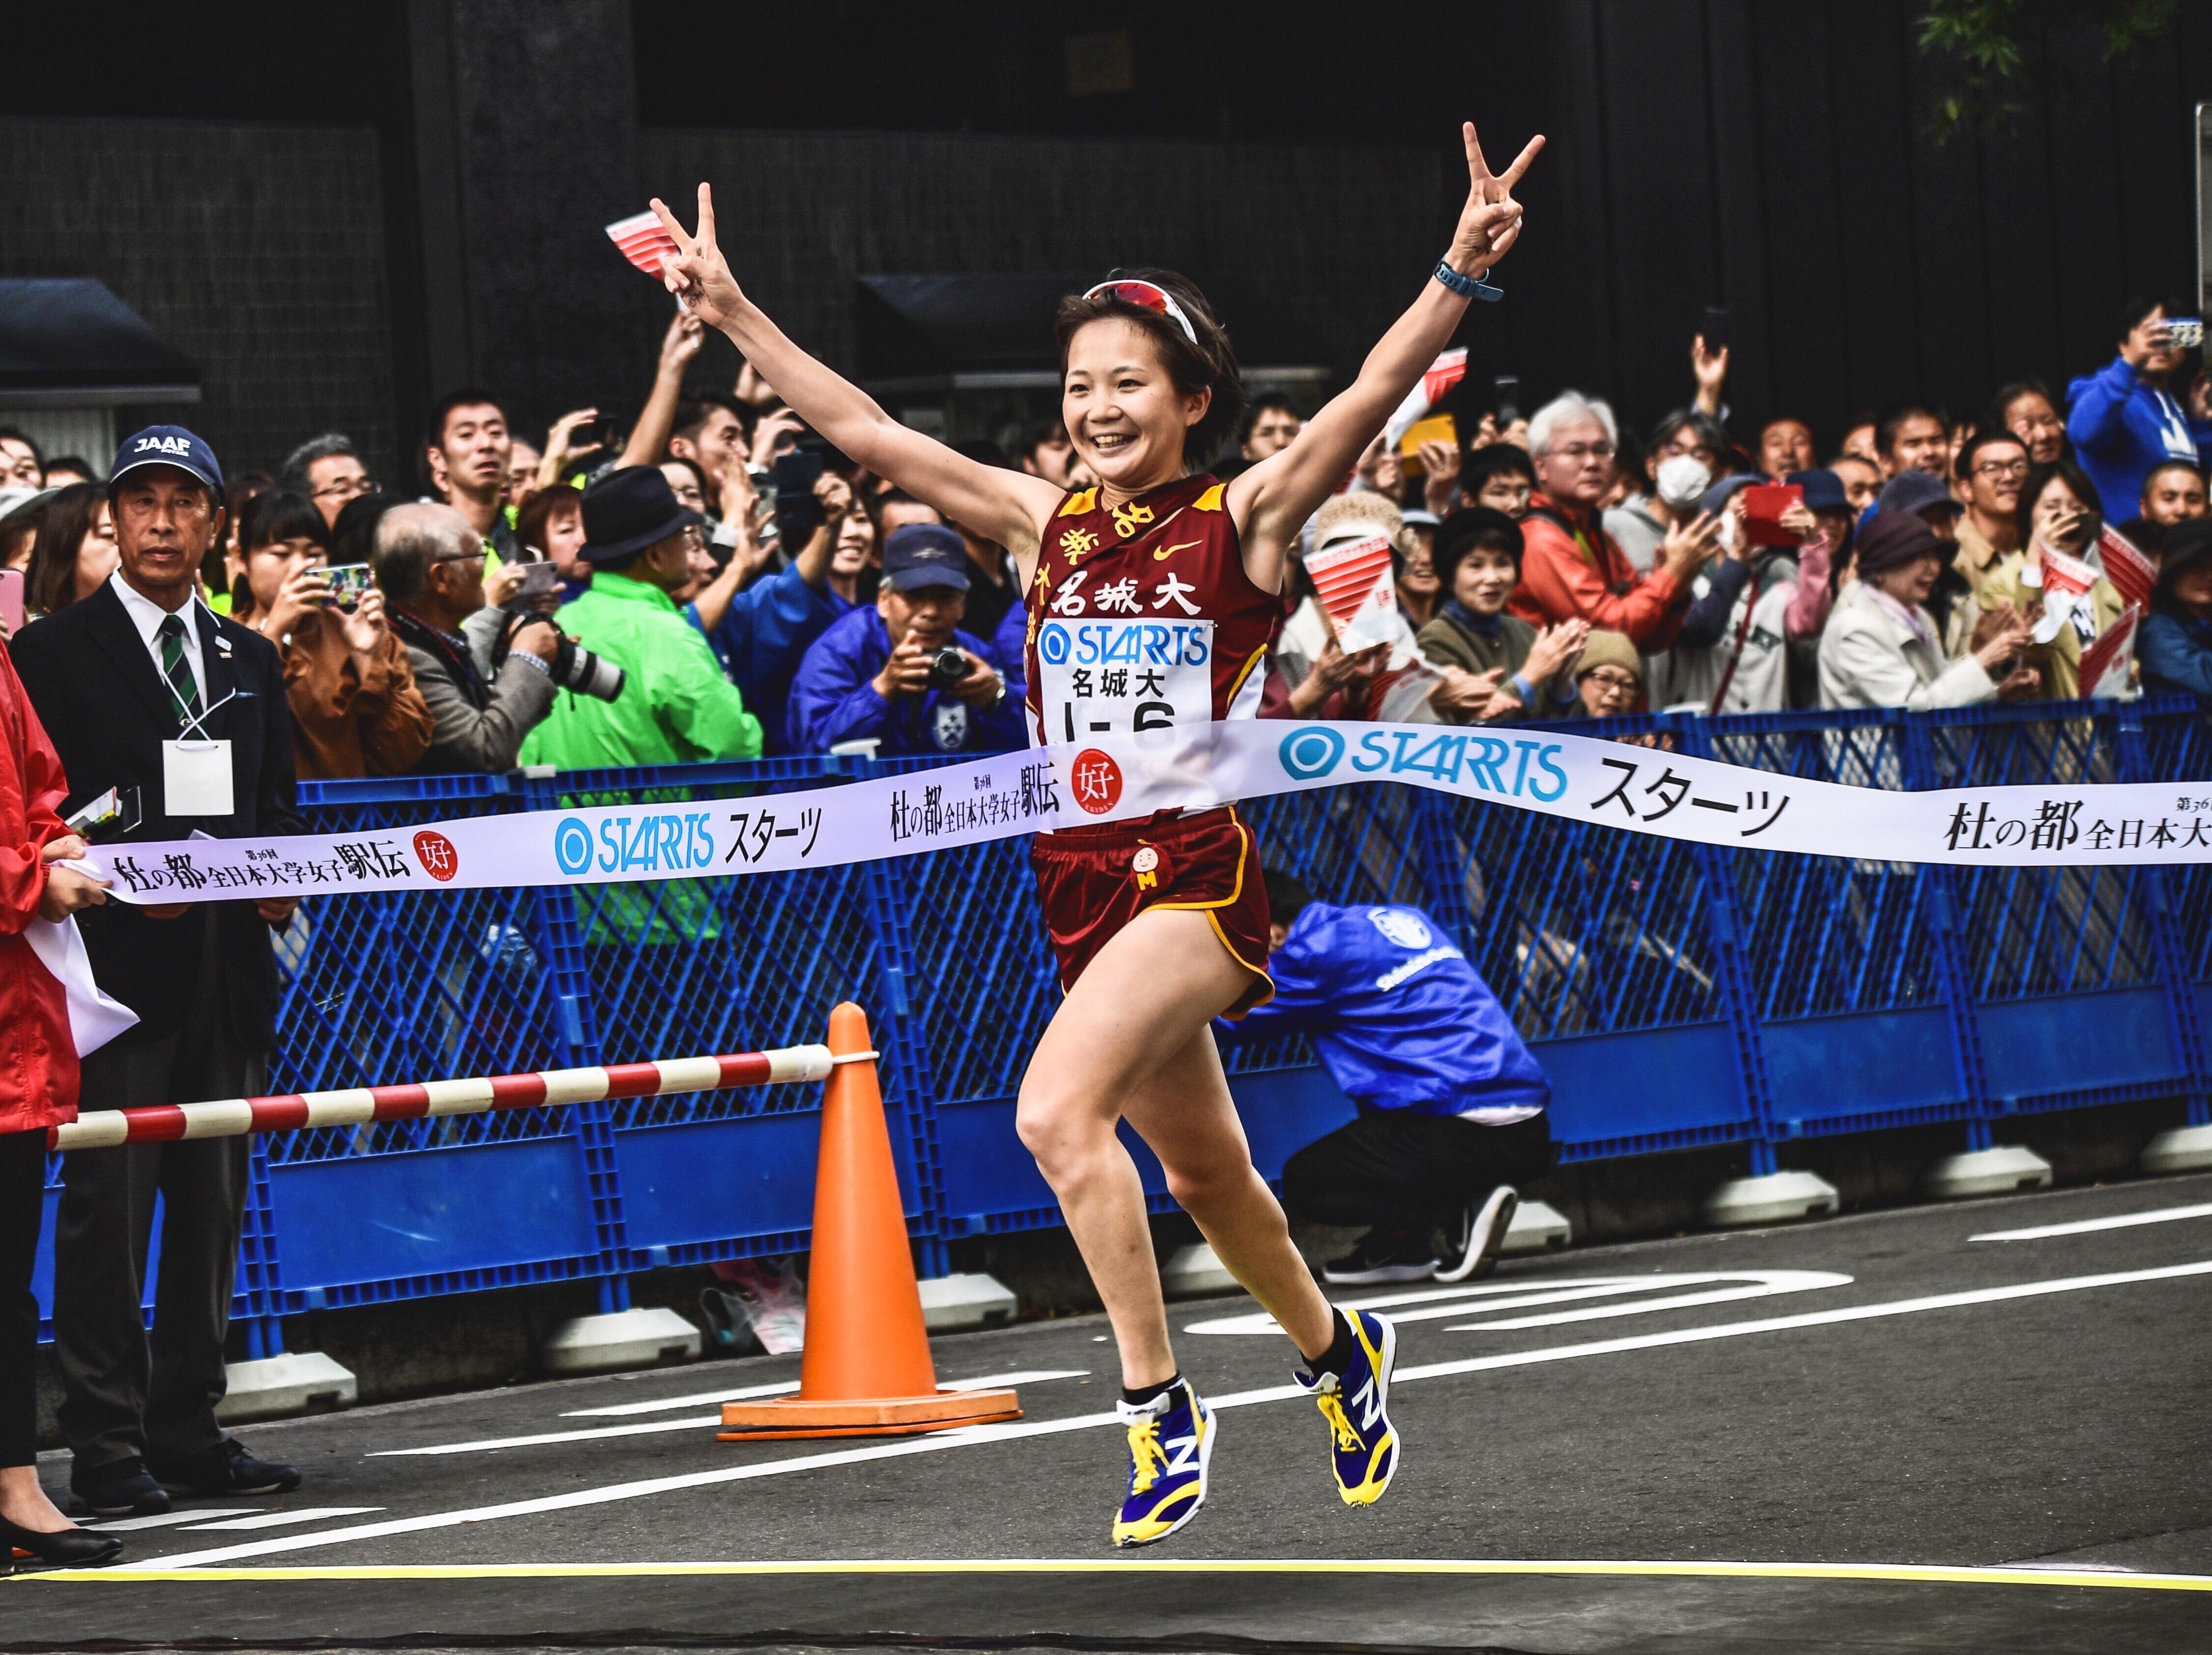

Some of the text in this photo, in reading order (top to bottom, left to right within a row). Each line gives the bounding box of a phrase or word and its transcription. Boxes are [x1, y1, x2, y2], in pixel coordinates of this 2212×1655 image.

[134, 436, 191, 453] JAAF
[1051, 570, 1202, 616] 名城大
[1072, 668, 1165, 698] 名城大
[1064, 701, 1175, 743] 1-6
[973, 774, 991, 792] 第36回
[1076, 761, 1115, 802] 好
[1590, 757, 1790, 837] スターツ
[2176, 797, 2212, 813] 第36
[725, 807, 822, 864] スターツ
[245, 848, 279, 862] 第36回
[420, 839, 451, 870] 好
[1136, 870, 1158, 891] M
